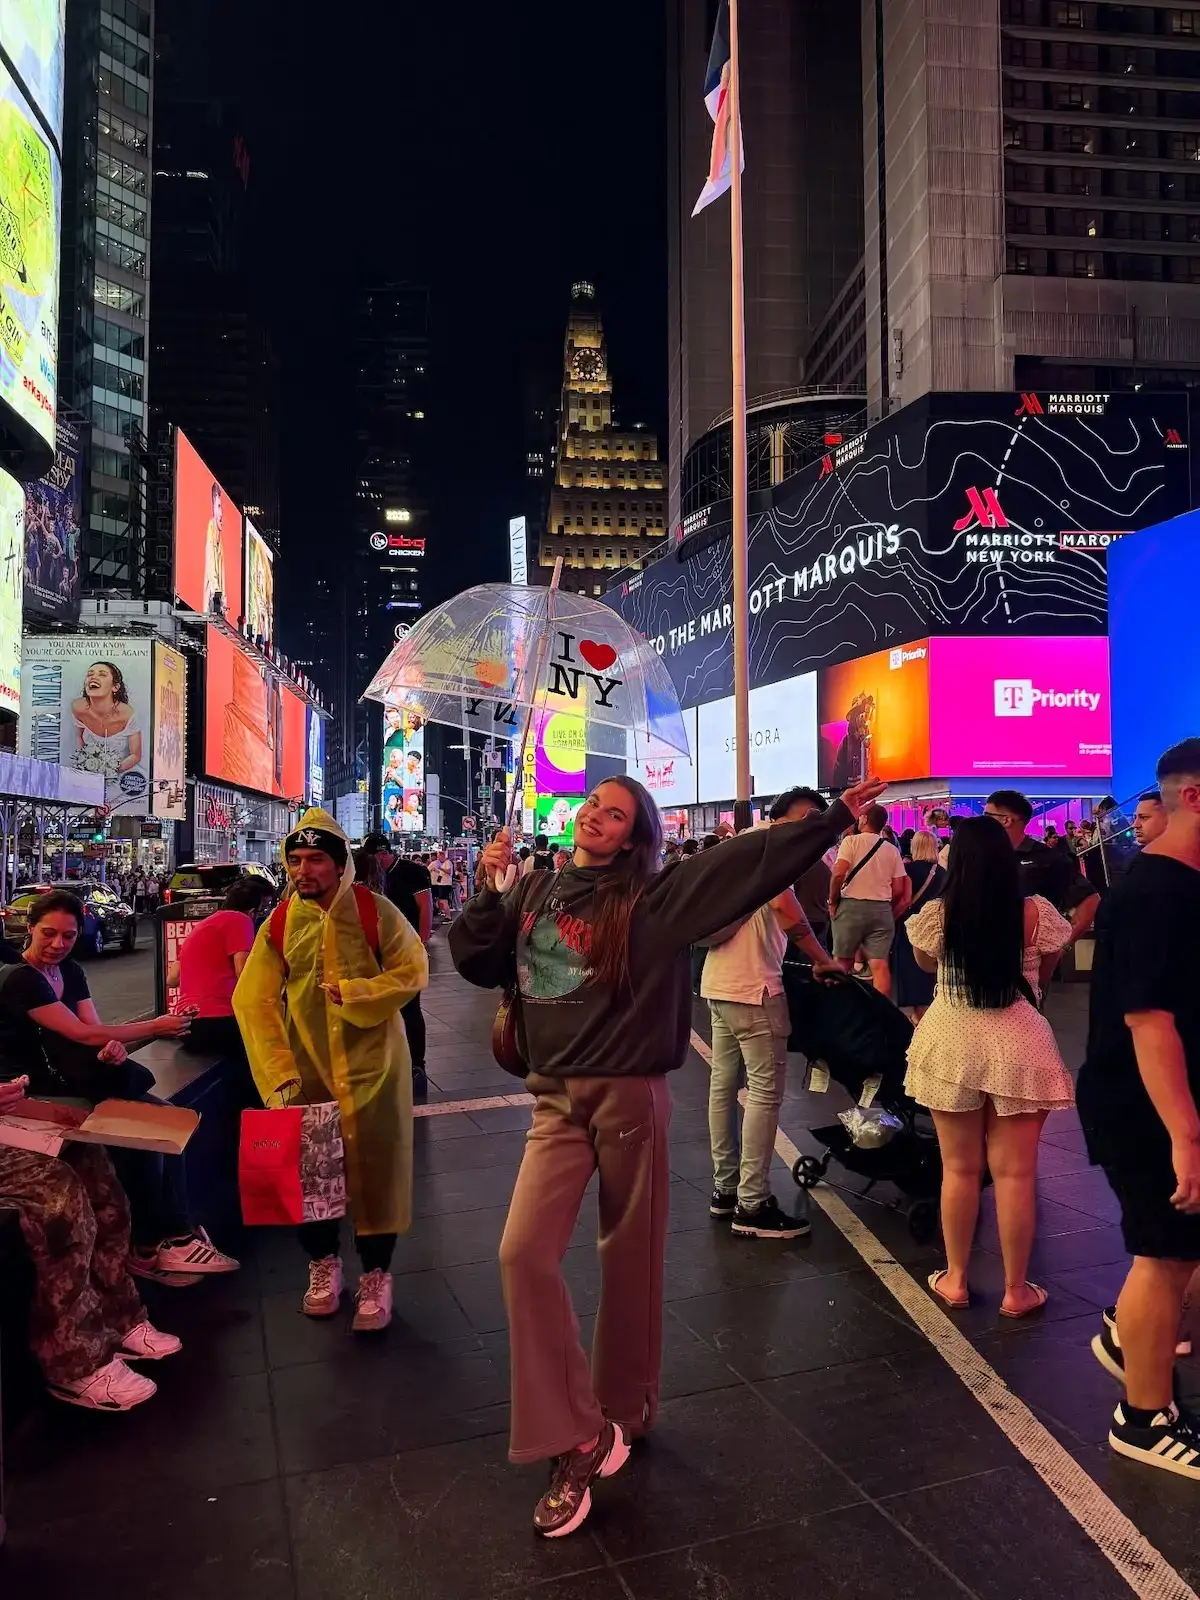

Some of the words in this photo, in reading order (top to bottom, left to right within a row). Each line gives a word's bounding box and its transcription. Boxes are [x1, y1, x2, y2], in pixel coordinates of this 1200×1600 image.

[5, 315, 23, 346] GIN
[1049, 394, 1110, 403] MARRIOTT
[1049, 404, 1103, 414] MARQUIS
[836, 431, 869, 458] MARRIOTT
[835, 444, 866, 468] MARQUIS
[965, 534, 1056, 546] MARRIOTT
[389, 549, 425, 557] CHICKEN
[965, 550, 1004, 562] NEW
[1010, 550, 1056, 562] YORK
[669, 621, 696, 651] THE
[793, 523, 901, 597] MARQUIS
[67, 641, 100, 649] ALREADY
[557, 631, 575, 663] I
[901, 647, 927, 662] Priority
[32, 664, 62, 707] MIA!
[548, 662, 623, 708] NY
[1032, 689, 1101, 711] Priority
[725, 727, 781, 753] SEHORA
[295, 829, 322, 846] NY
